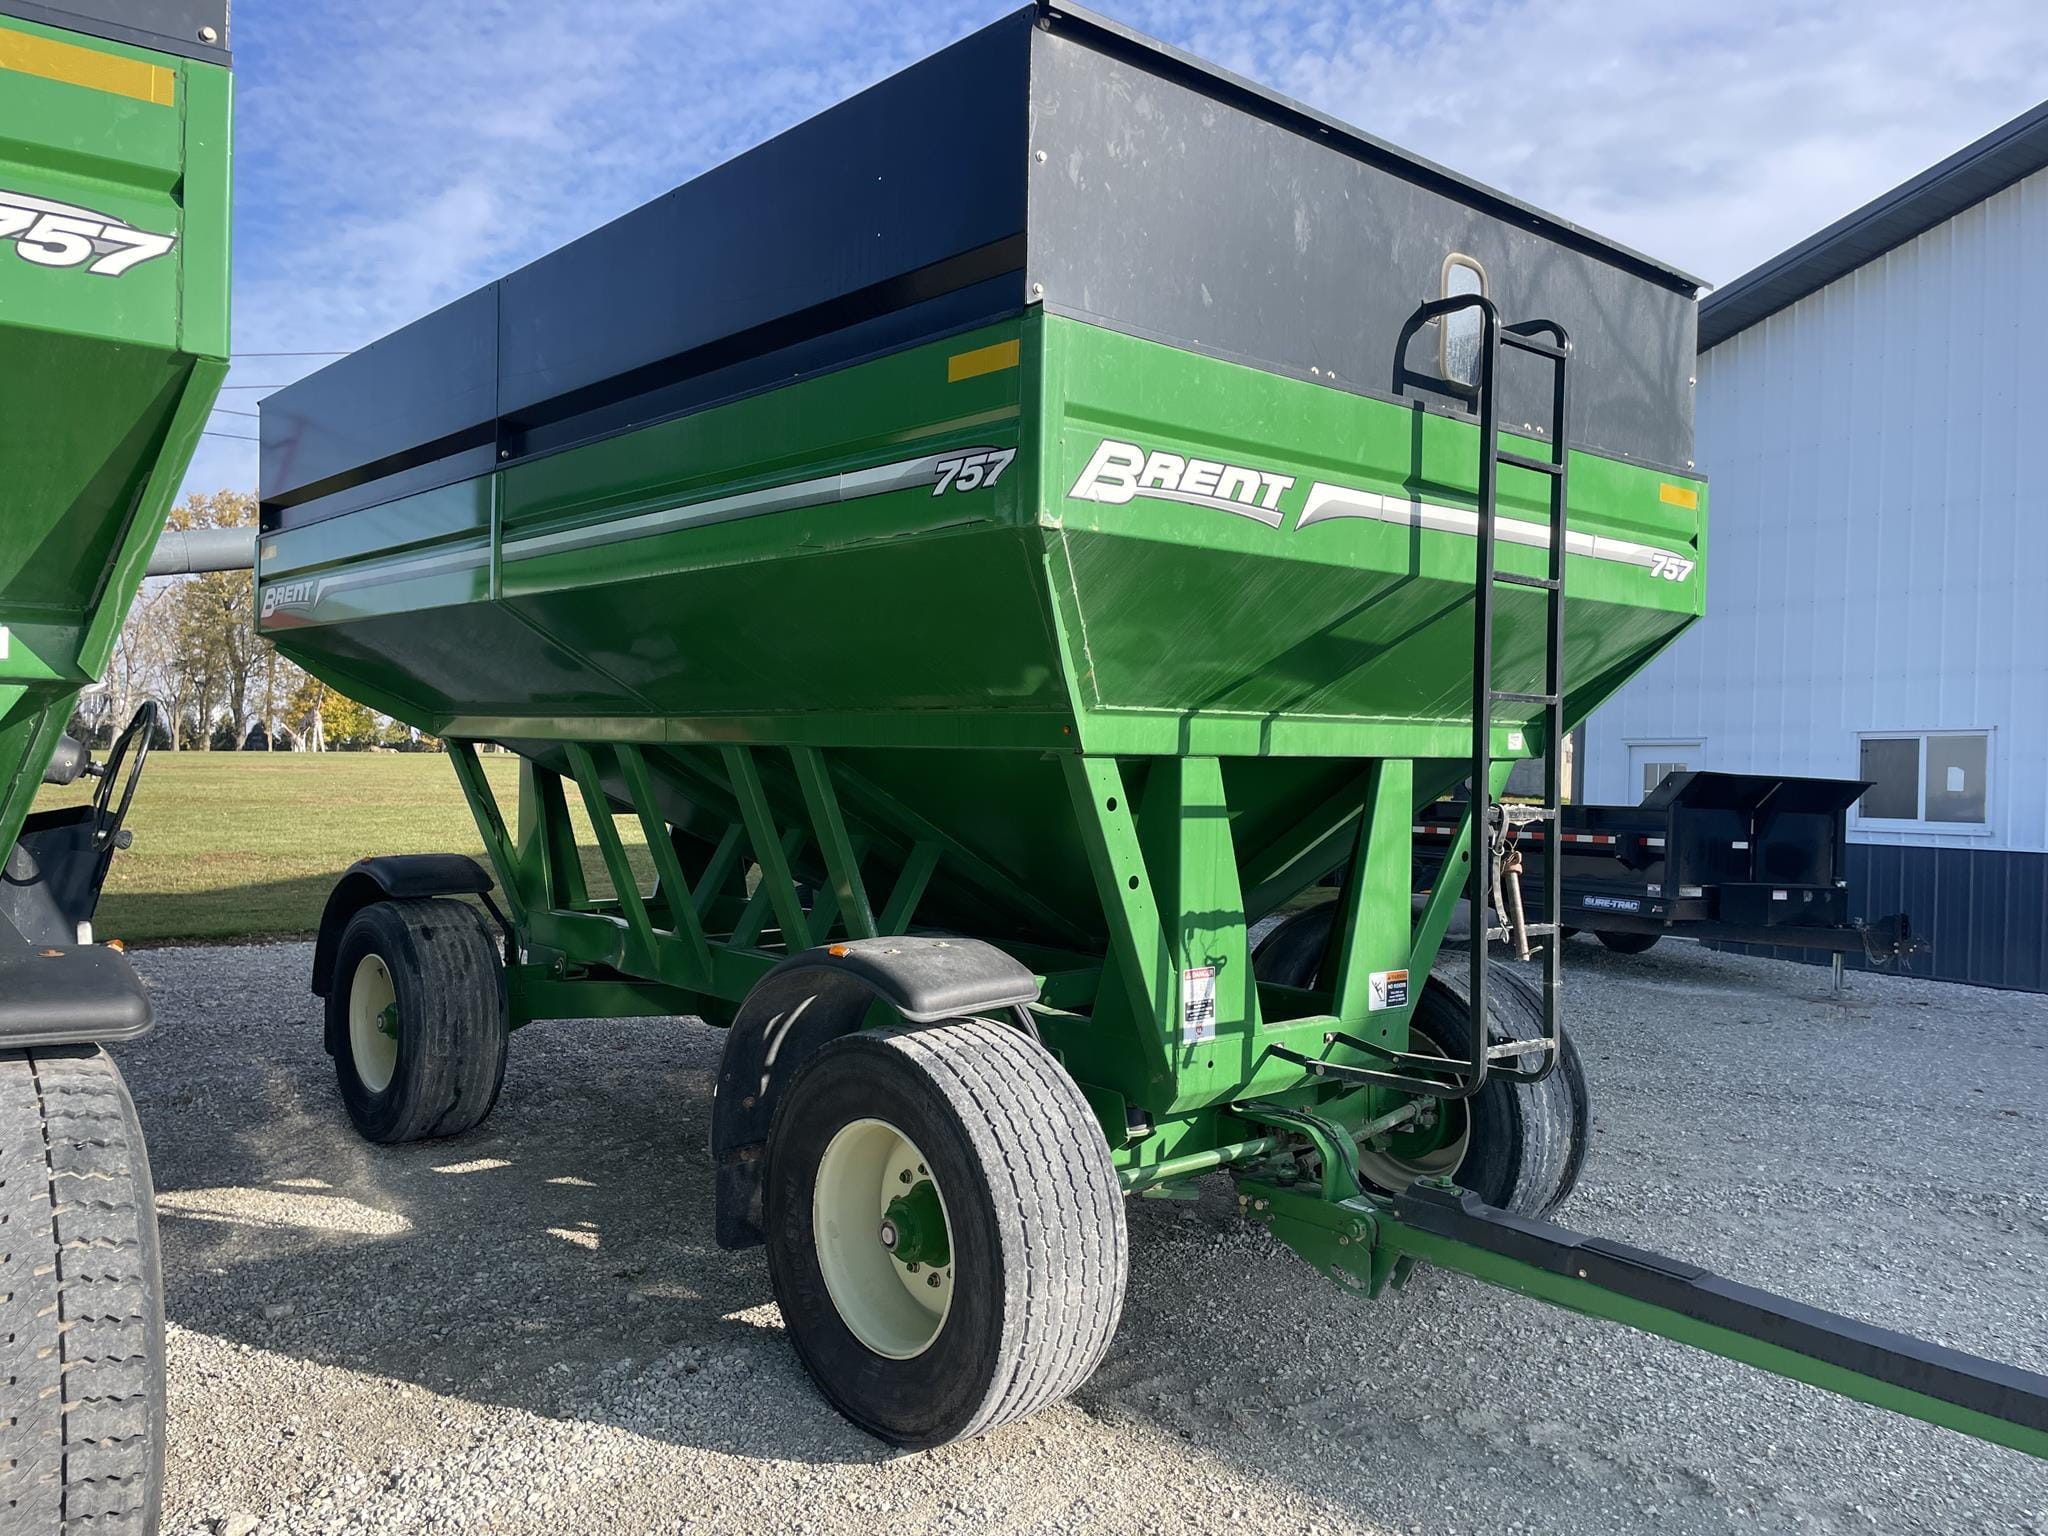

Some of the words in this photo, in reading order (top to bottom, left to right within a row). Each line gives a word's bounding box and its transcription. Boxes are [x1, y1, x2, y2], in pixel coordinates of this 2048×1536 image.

[931, 447, 1017, 496] 757
[1068, 439, 1296, 512] BRENT
[1651, 554, 1694, 582] 757
[261, 580, 313, 618] BRENT
[1584, 897, 1639, 910] SURE-TRAC
